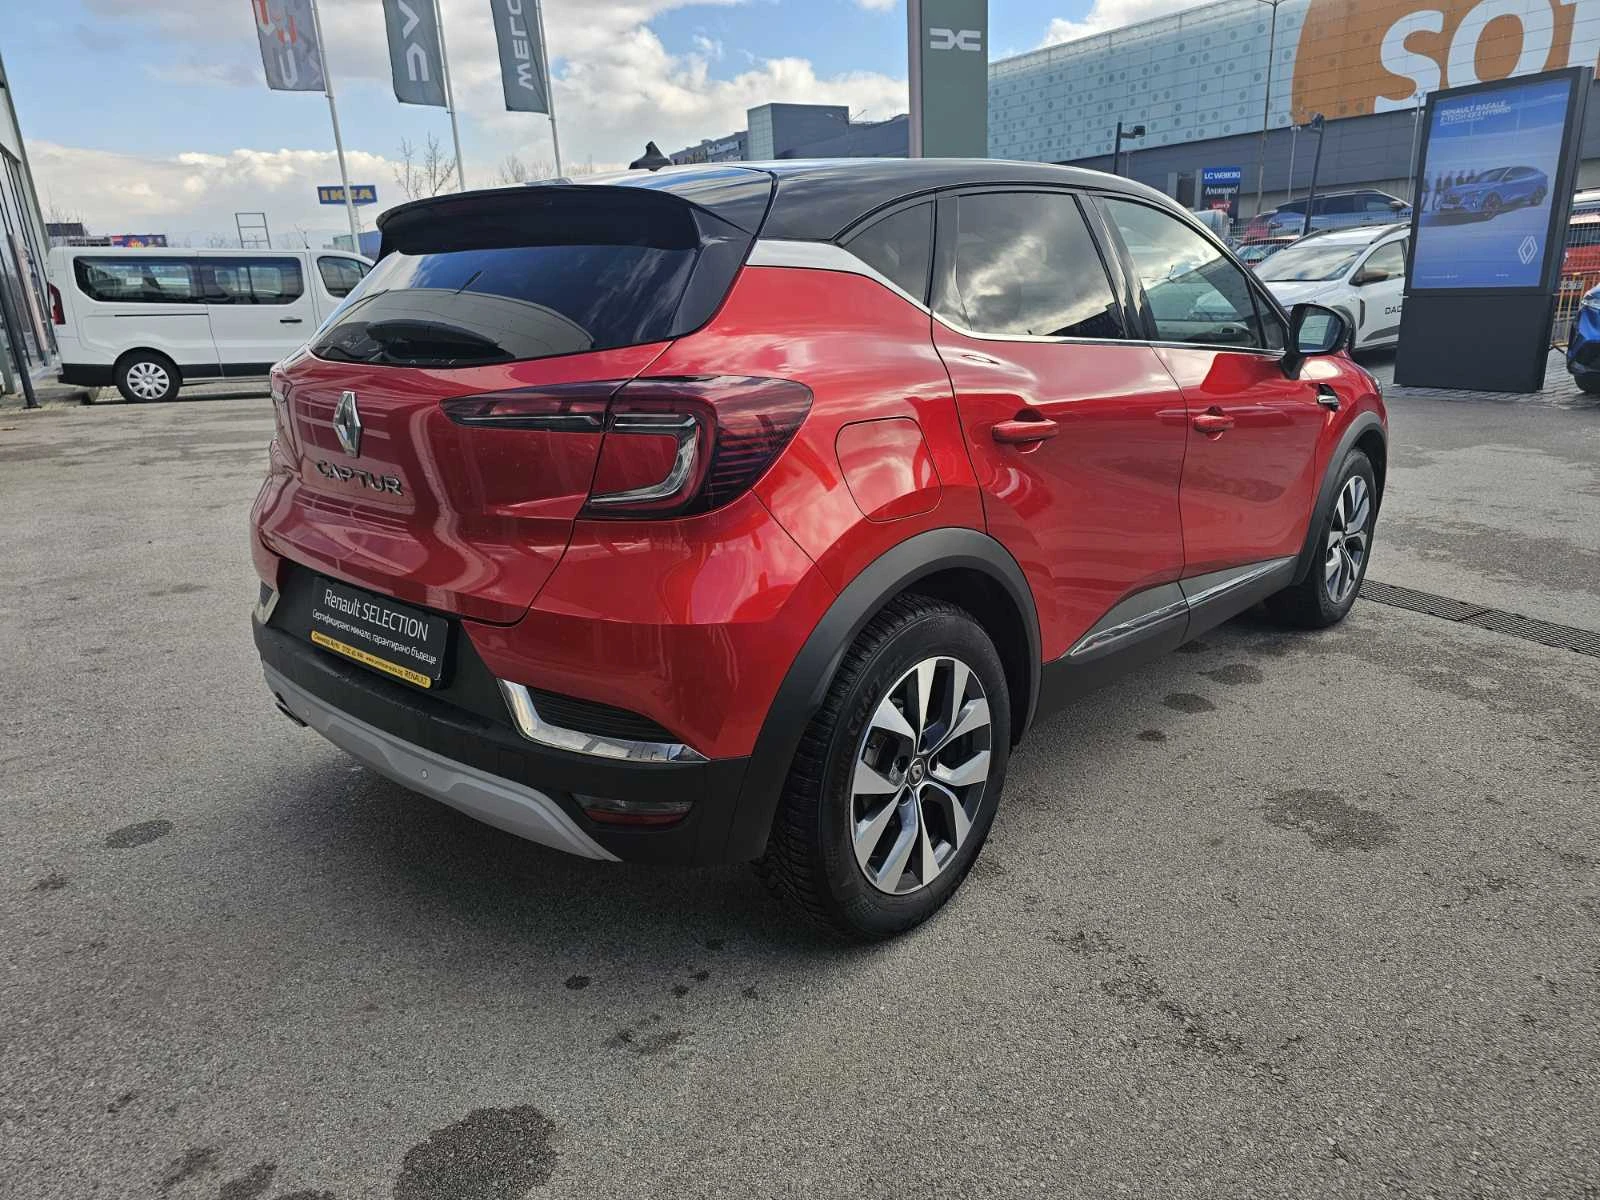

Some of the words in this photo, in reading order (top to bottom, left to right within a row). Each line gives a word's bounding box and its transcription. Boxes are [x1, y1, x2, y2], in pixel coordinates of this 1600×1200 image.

[316, 460, 404, 496] CAPTUR
[324, 589, 361, 617] Renault
[362, 602, 429, 641] SELECTION
[373, 633, 410, 655] гарантирано
[411, 646, 437, 664] бъдеще
[404, 670, 429, 685] RENAULT
